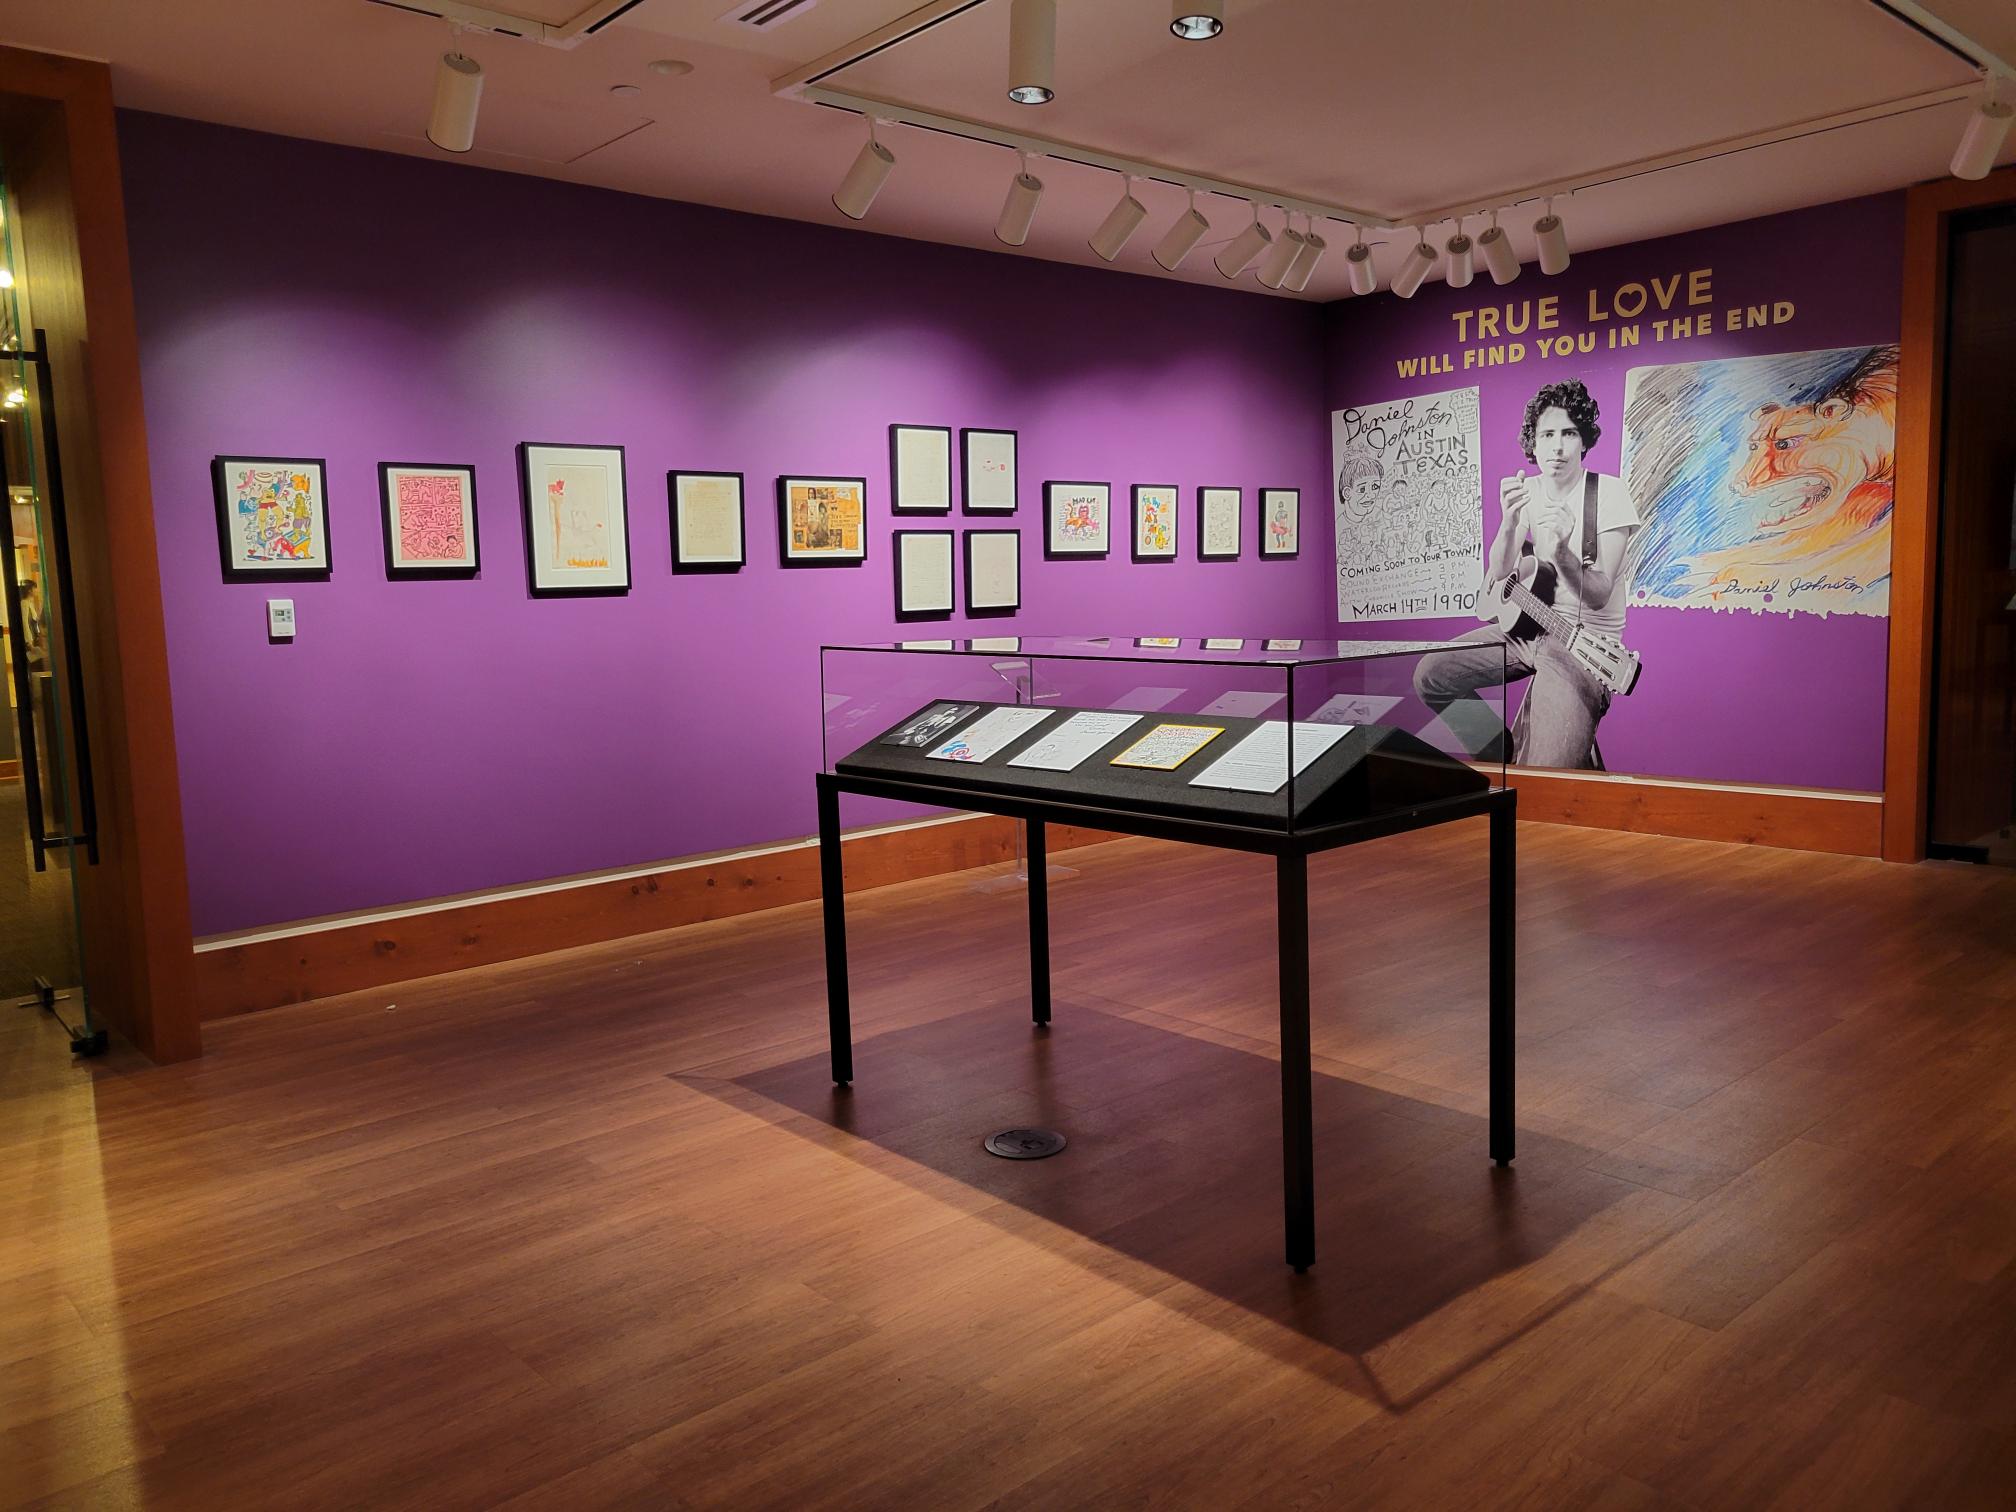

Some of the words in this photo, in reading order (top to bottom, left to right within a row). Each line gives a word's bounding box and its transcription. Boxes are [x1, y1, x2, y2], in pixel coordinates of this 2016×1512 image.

[1452, 296, 1559, 342] TRUE
[1588, 268, 1713, 322] LOVE
[1397, 353, 1454, 378] WILL
[1463, 343, 1526, 369] FIND
[1536, 331, 1596, 358] YOU
[1608, 325, 1640, 349] IN
[1652, 313, 1712, 342] THE
[1727, 301, 1795, 331] END
[1343, 400, 1414, 445] Daniel
[1366, 401, 1452, 458] Johnston
[1417, 428, 1435, 441] IN
[1396, 434, 1466, 461] AUSTIN
[1340, 563, 1381, 578] COMING
[1383, 559, 1406, 571] SOON
[1420, 551, 1441, 563] YOUR
[1443, 543, 1482, 560] TOWN!!
[1720, 578, 1778, 595] Daniel
[1787, 575, 1864, 598] Johnston
[1352, 602, 1397, 619] MARCH
[1401, 598, 1428, 614] 14TH
